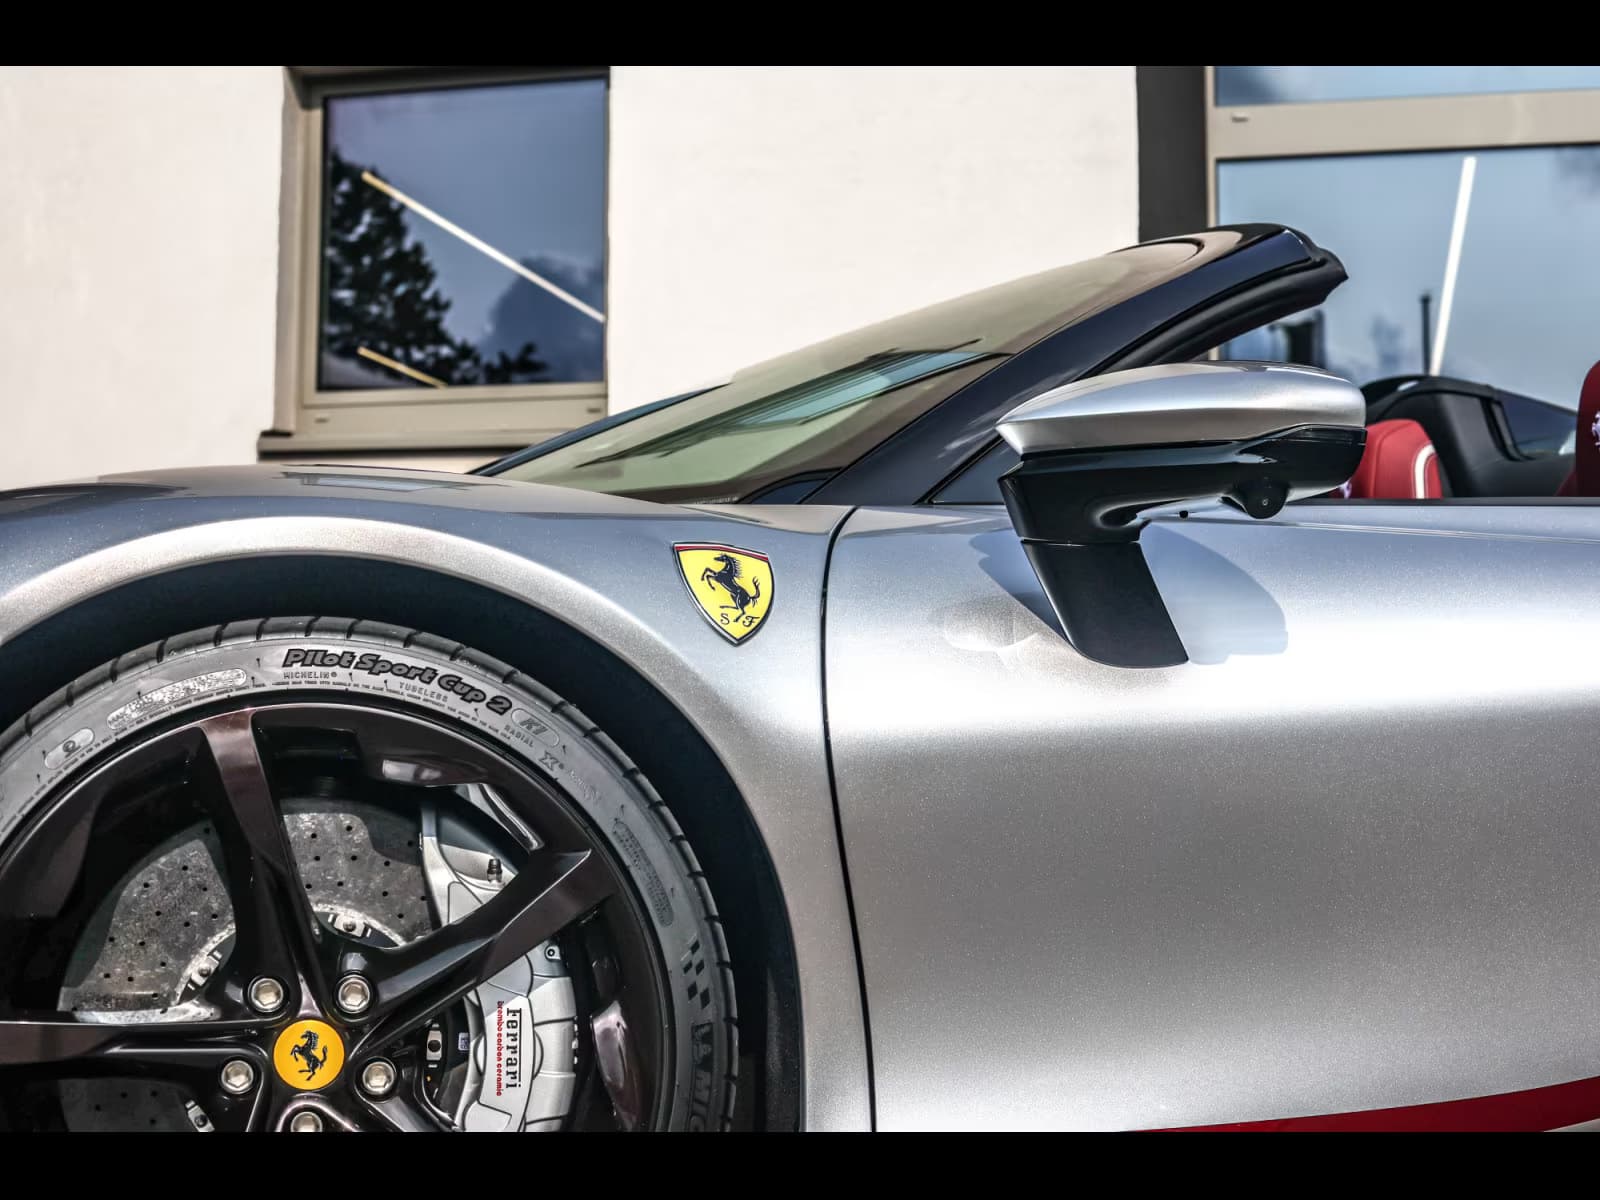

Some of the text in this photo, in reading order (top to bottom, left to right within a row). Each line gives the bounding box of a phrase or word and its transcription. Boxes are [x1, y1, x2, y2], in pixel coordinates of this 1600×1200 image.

[282, 648, 355, 669] Pilot
[355, 652, 437, 685] Sport
[437, 675, 487, 704] Cup
[485, 695, 513, 716] 2
[503, 724, 535, 748] RADIAL
[505, 1008, 522, 1088] Ferrari
